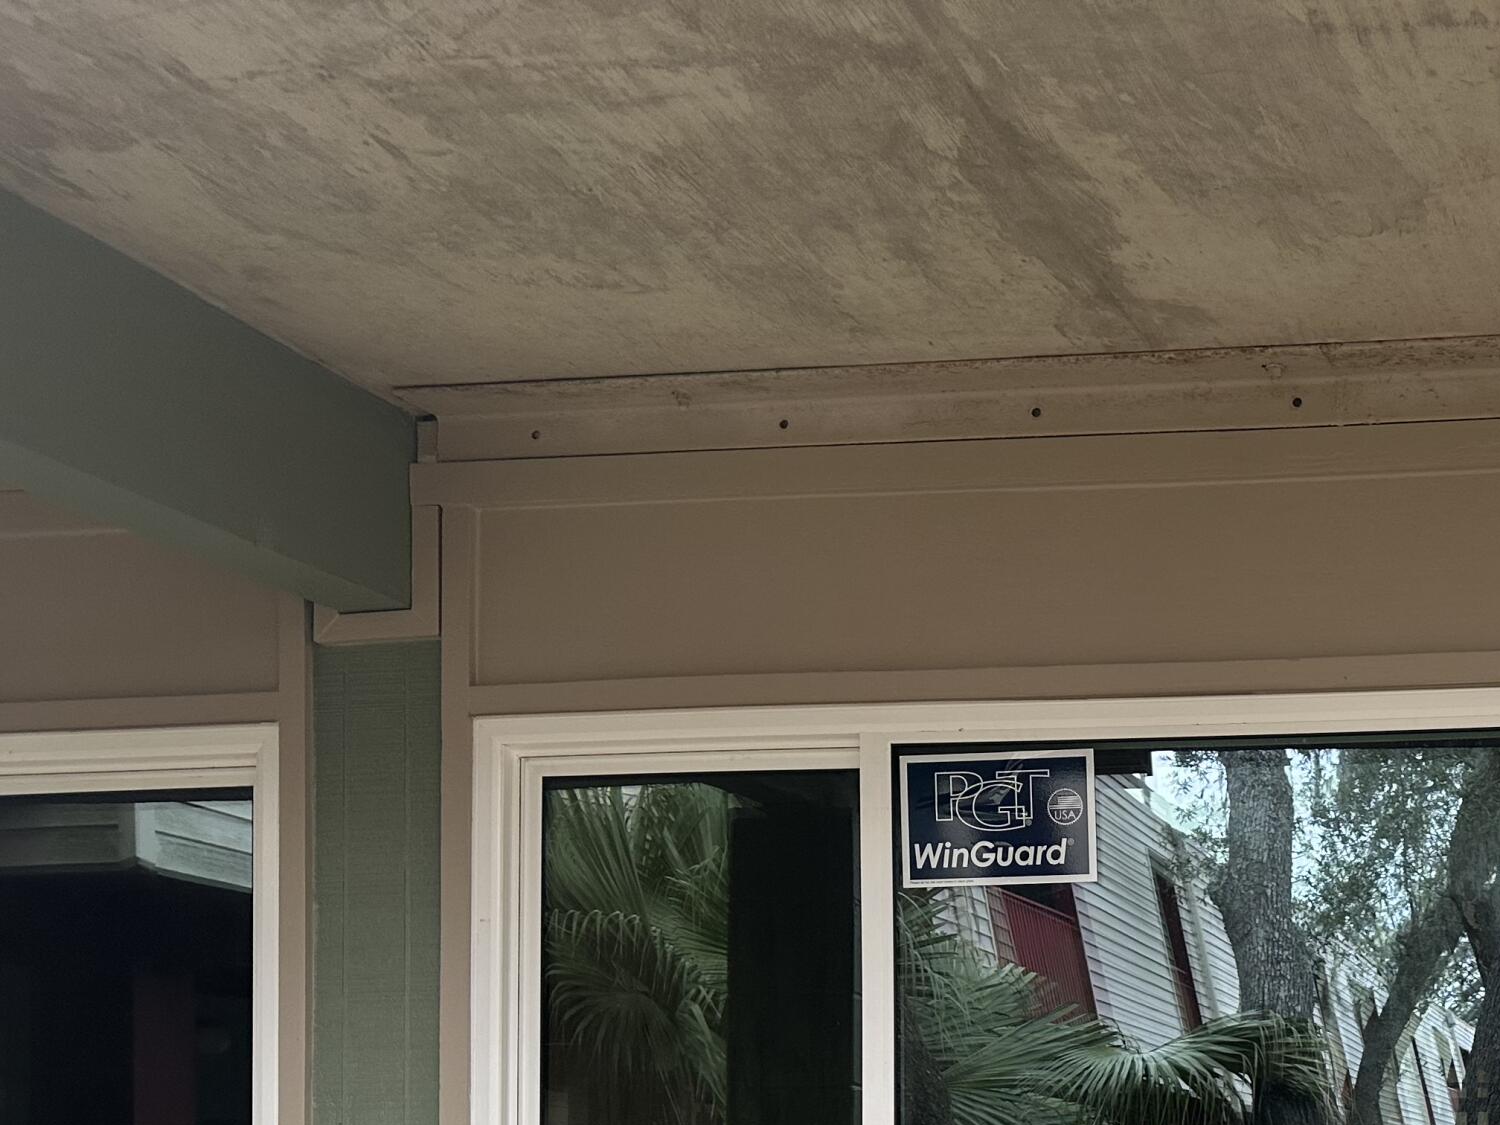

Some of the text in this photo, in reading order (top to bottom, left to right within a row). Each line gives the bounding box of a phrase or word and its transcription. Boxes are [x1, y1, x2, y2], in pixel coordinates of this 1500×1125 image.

[934, 769, 1050, 832] PGT
[1054, 809, 1077, 821] USA
[913, 837, 1068, 870] WinGuard
